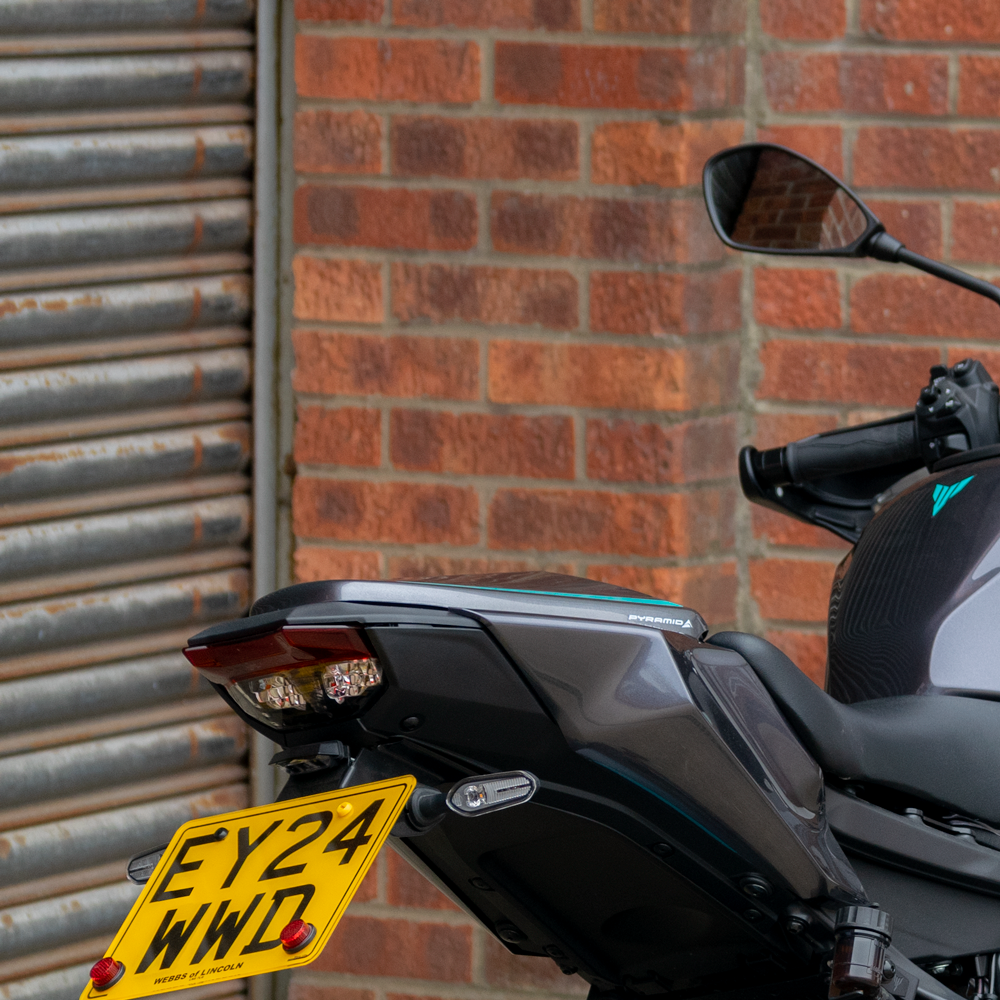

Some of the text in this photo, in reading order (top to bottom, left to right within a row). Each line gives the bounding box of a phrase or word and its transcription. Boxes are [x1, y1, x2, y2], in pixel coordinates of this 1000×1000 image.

[628, 614, 684, 626] PYRAMID
[149, 798, 385, 903] EY24
[134, 884, 316, 974] WWD
[153, 972, 188, 985] WEBBS
[189, 970, 201, 979] of
[200, 962, 244, 976] LINCOLN
